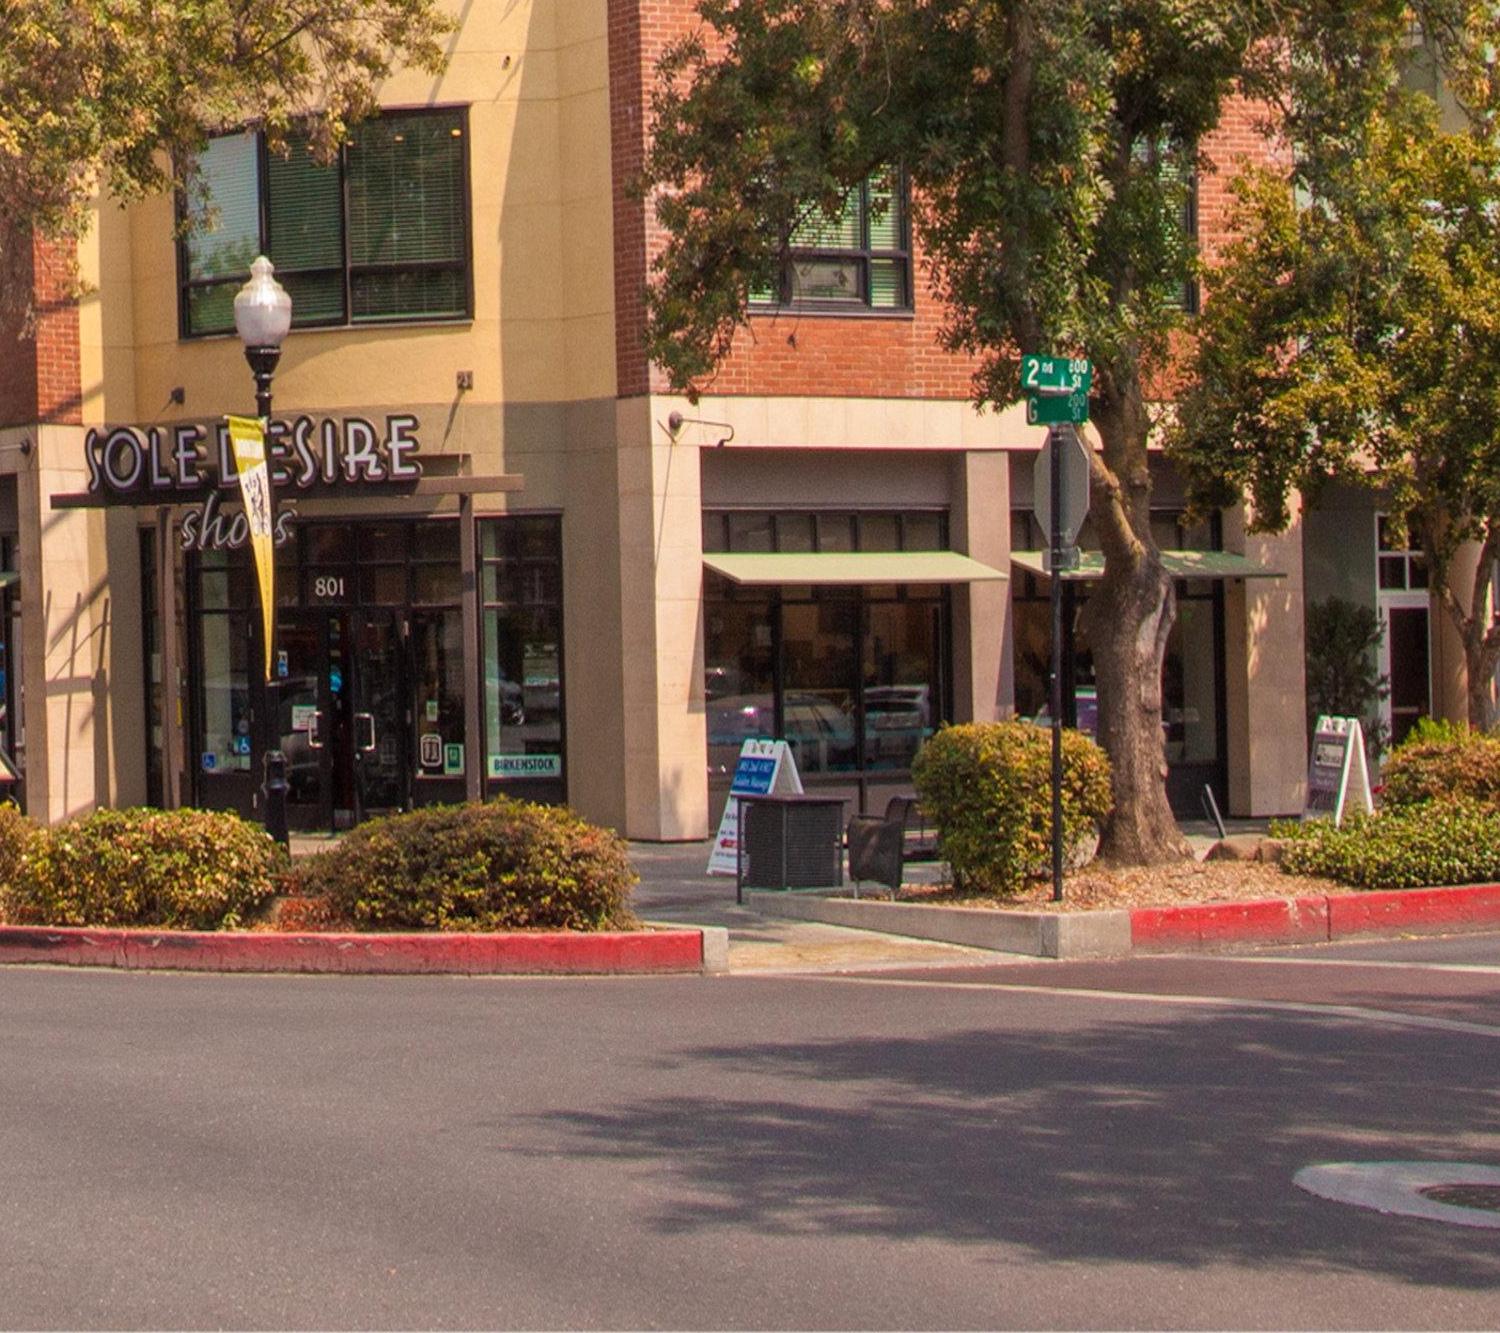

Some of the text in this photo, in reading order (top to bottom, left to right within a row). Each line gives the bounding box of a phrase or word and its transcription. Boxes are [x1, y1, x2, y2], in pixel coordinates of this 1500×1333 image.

[1027, 358, 1082, 388] 2nd St
[1028, 397, 1081, 423] G St
[86, 426, 203, 494] SOLE
[181, 489, 298, 551] shos
[315, 576, 345, 597] 801
[494, 757, 555, 771] BIRKENSTOCK
